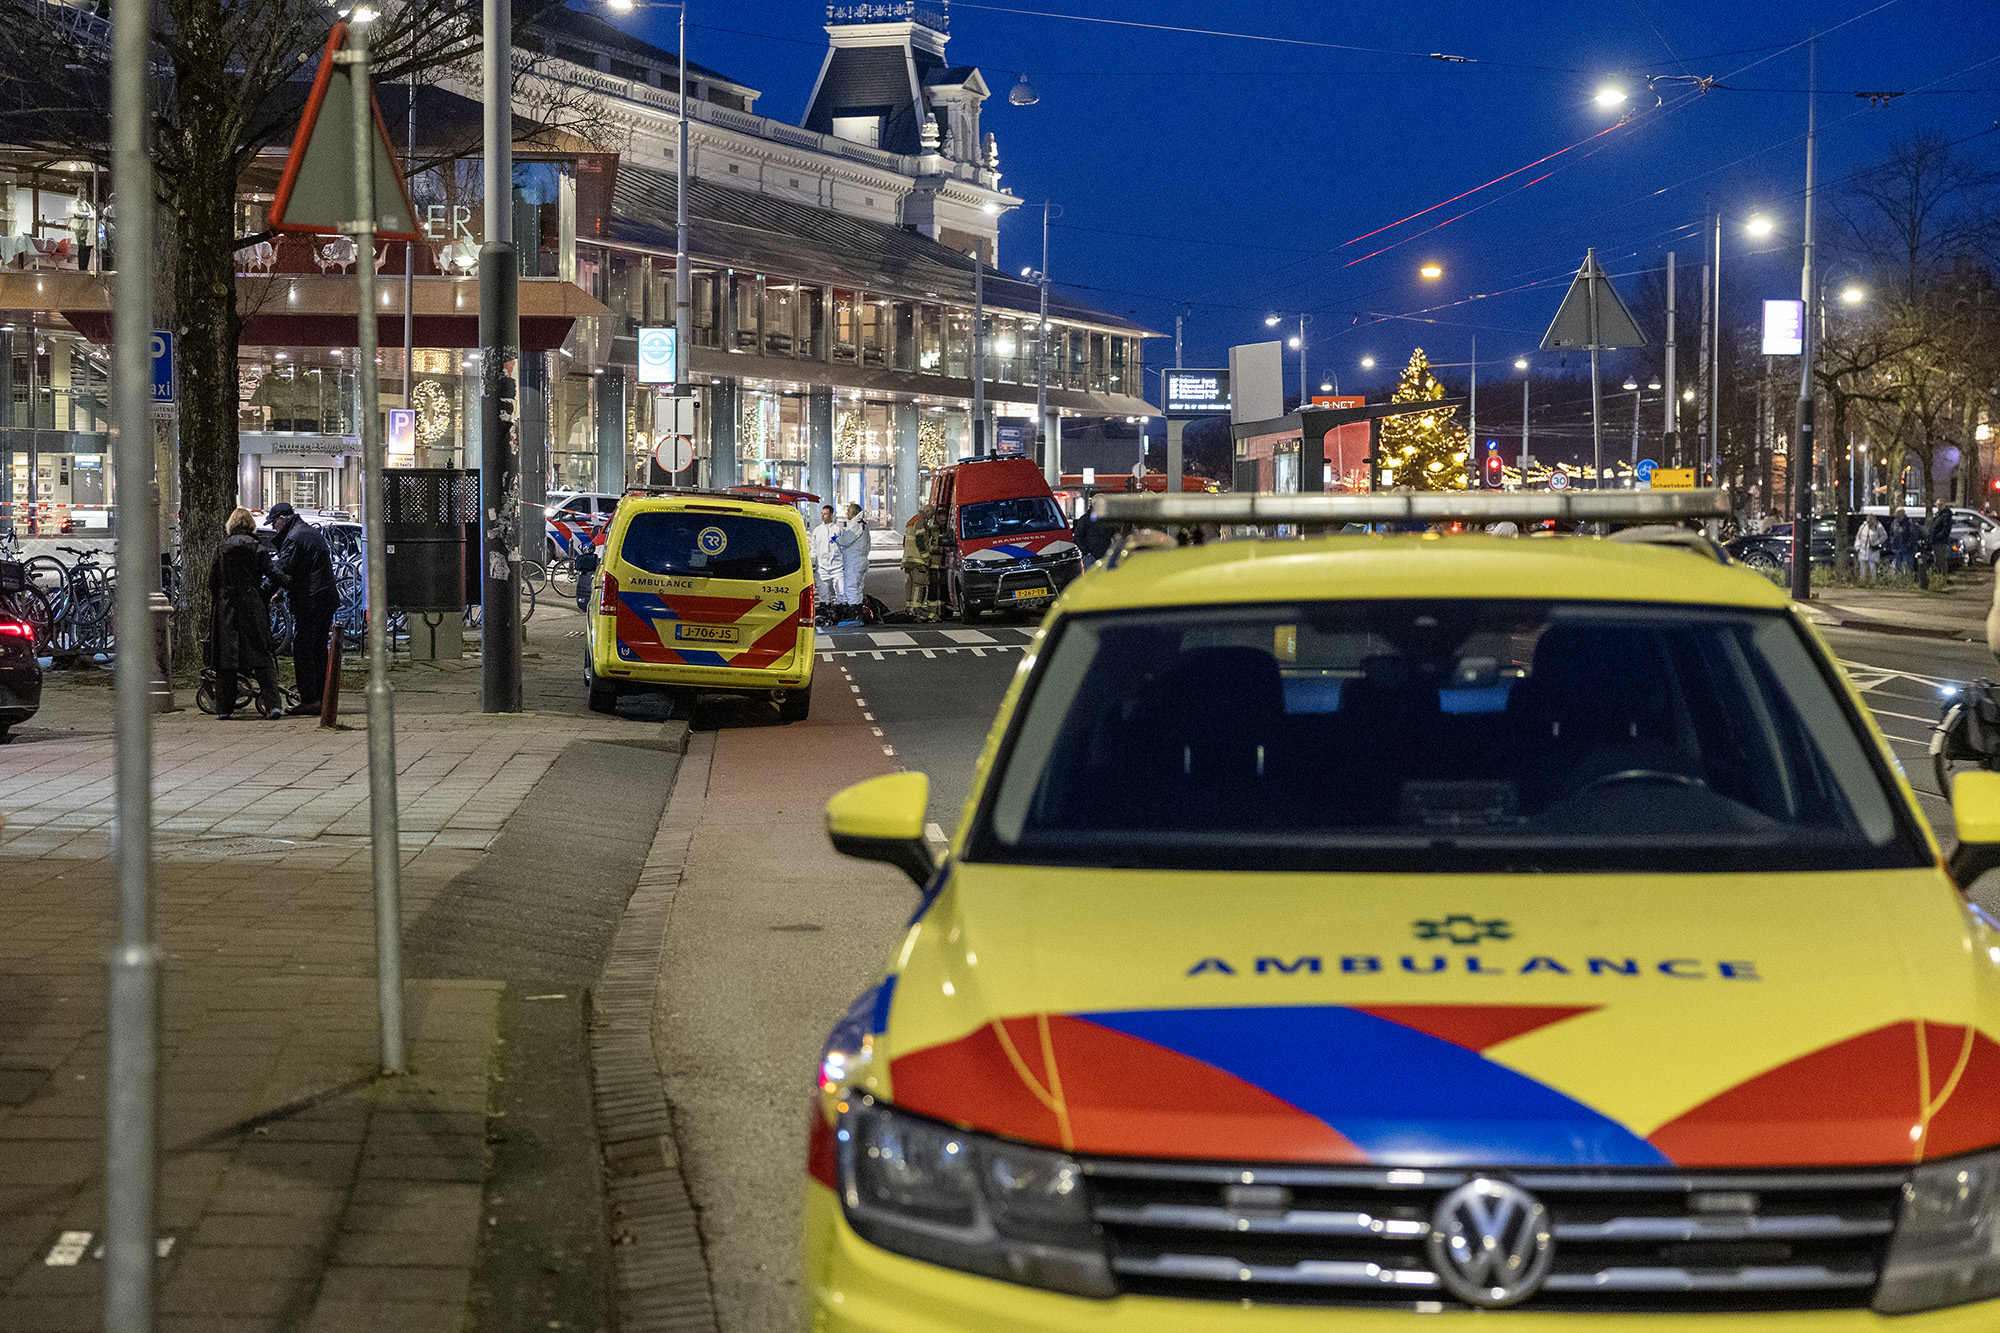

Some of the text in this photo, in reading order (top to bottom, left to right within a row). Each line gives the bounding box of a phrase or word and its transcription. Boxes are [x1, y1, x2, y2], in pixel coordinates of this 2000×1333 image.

[414, 204, 475, 239] ER
[150, 381, 171, 396] axi
[394, 412, 410, 435] P
[1553, 476, 1566, 486] 30
[992, 535, 1047, 545] BRANDWEER
[630, 577, 694, 589] AMBULANCE
[761, 585, 790, 595] 13-342
[685, 627, 732, 639] J-706-JS
[1184, 954, 1764, 983] AMBULANCE
